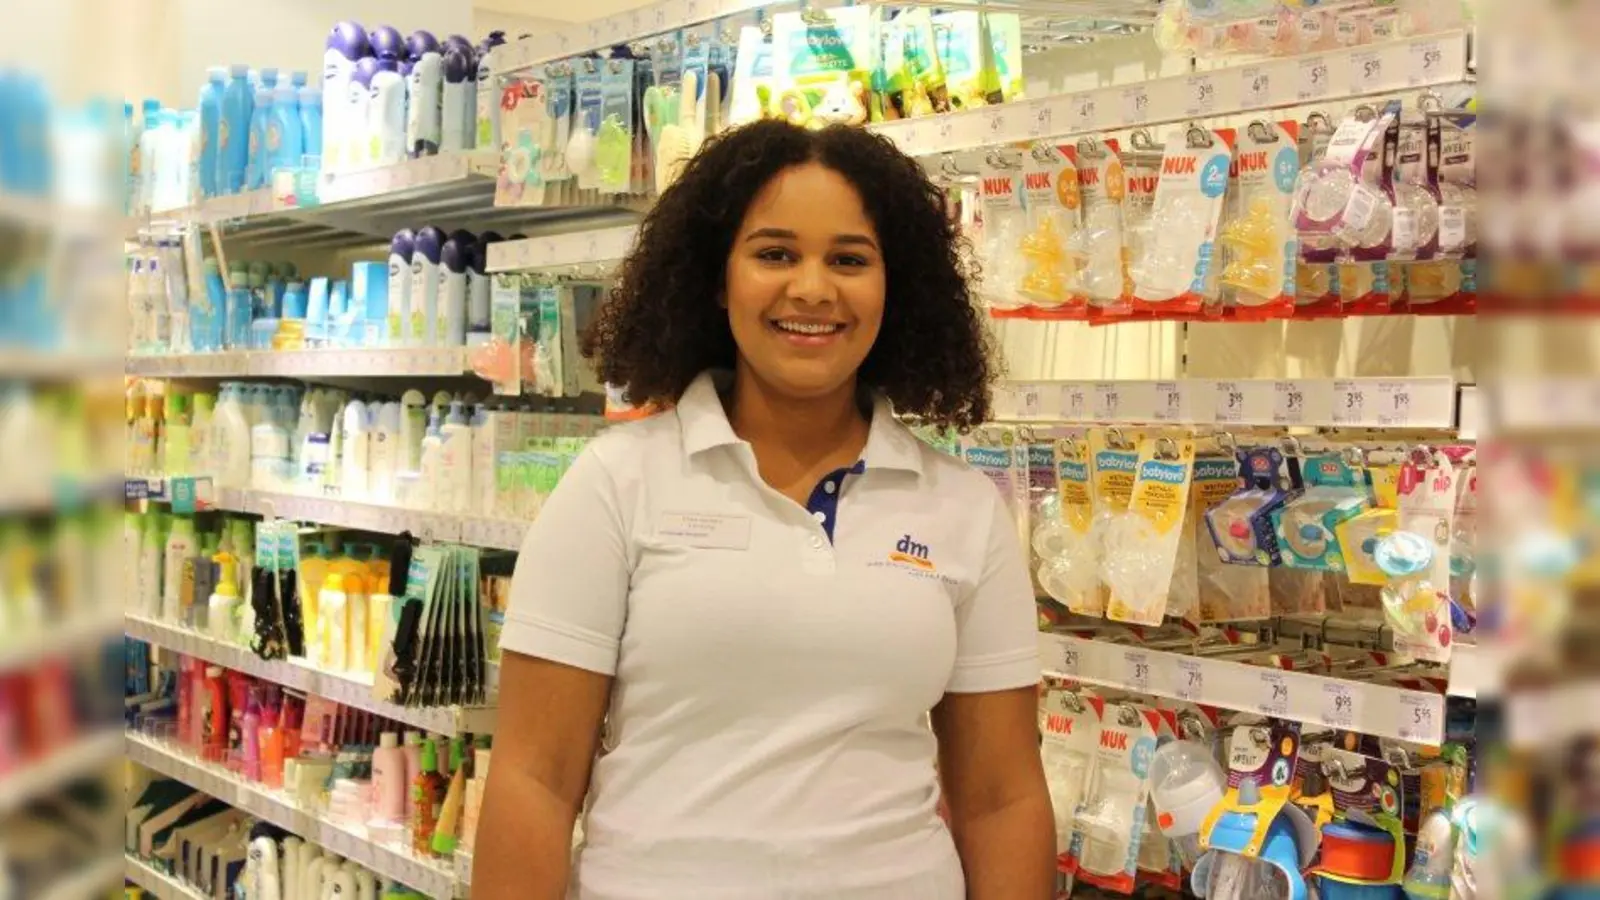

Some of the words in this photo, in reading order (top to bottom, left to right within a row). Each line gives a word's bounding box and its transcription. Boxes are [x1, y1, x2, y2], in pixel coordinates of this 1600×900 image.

[1163, 156, 1196, 174] NUK
[1240, 151, 1267, 173] NUK
[983, 178, 1012, 195] NUK
[1026, 172, 1051, 190] NUK
[896, 534, 929, 559] dm
[1046, 713, 1072, 734] NUK
[1100, 729, 1127, 750] NUK
